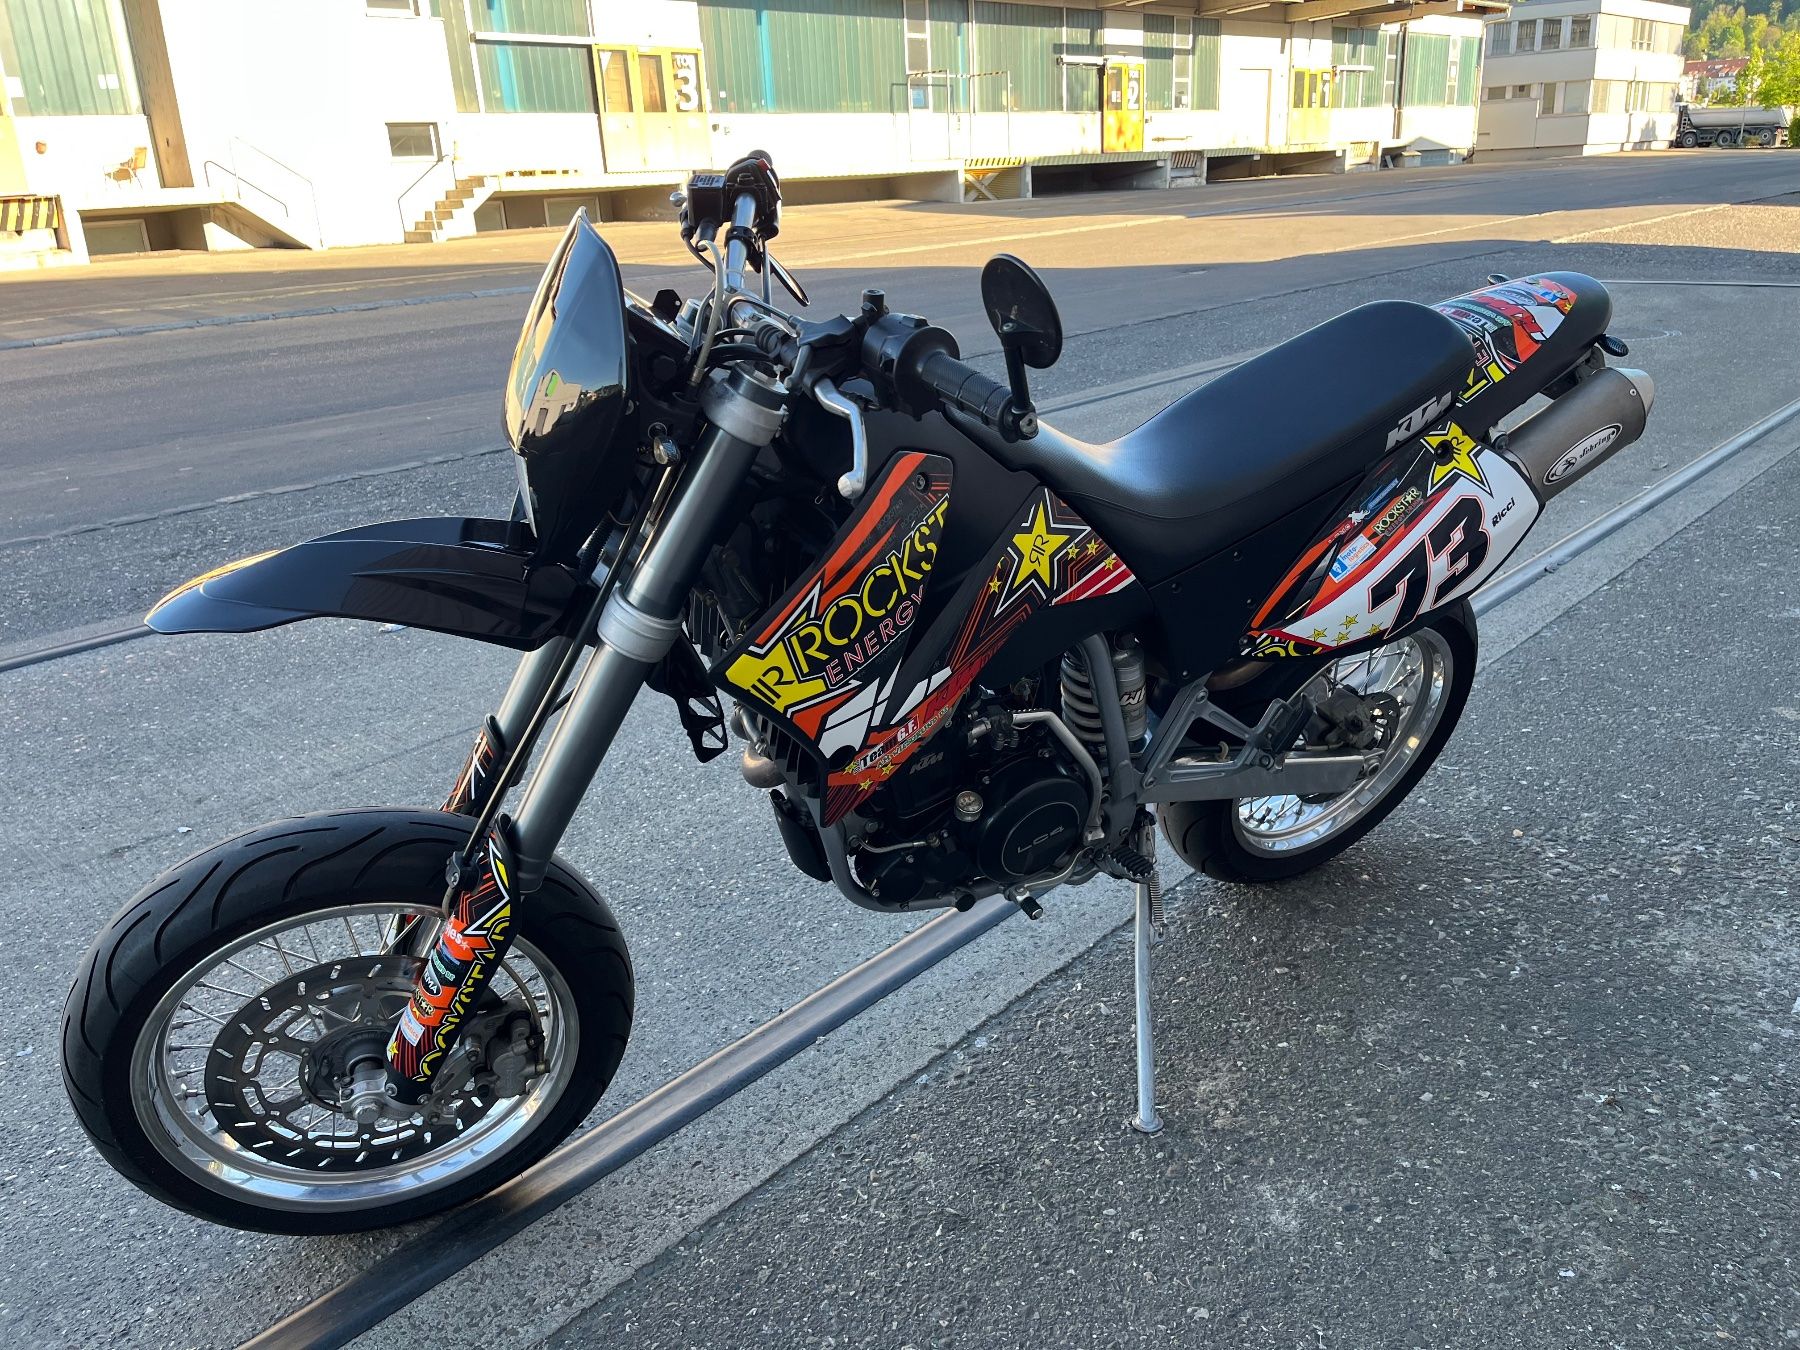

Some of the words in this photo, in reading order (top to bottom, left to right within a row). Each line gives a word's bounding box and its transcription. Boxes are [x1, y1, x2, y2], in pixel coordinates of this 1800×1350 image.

[675, 68, 700, 112] 3
[1127, 80, 1140, 110] 2
[1384, 390, 1453, 452] KTM
[1491, 497, 1516, 528] Ricci
[1368, 494, 1491, 639] 73
